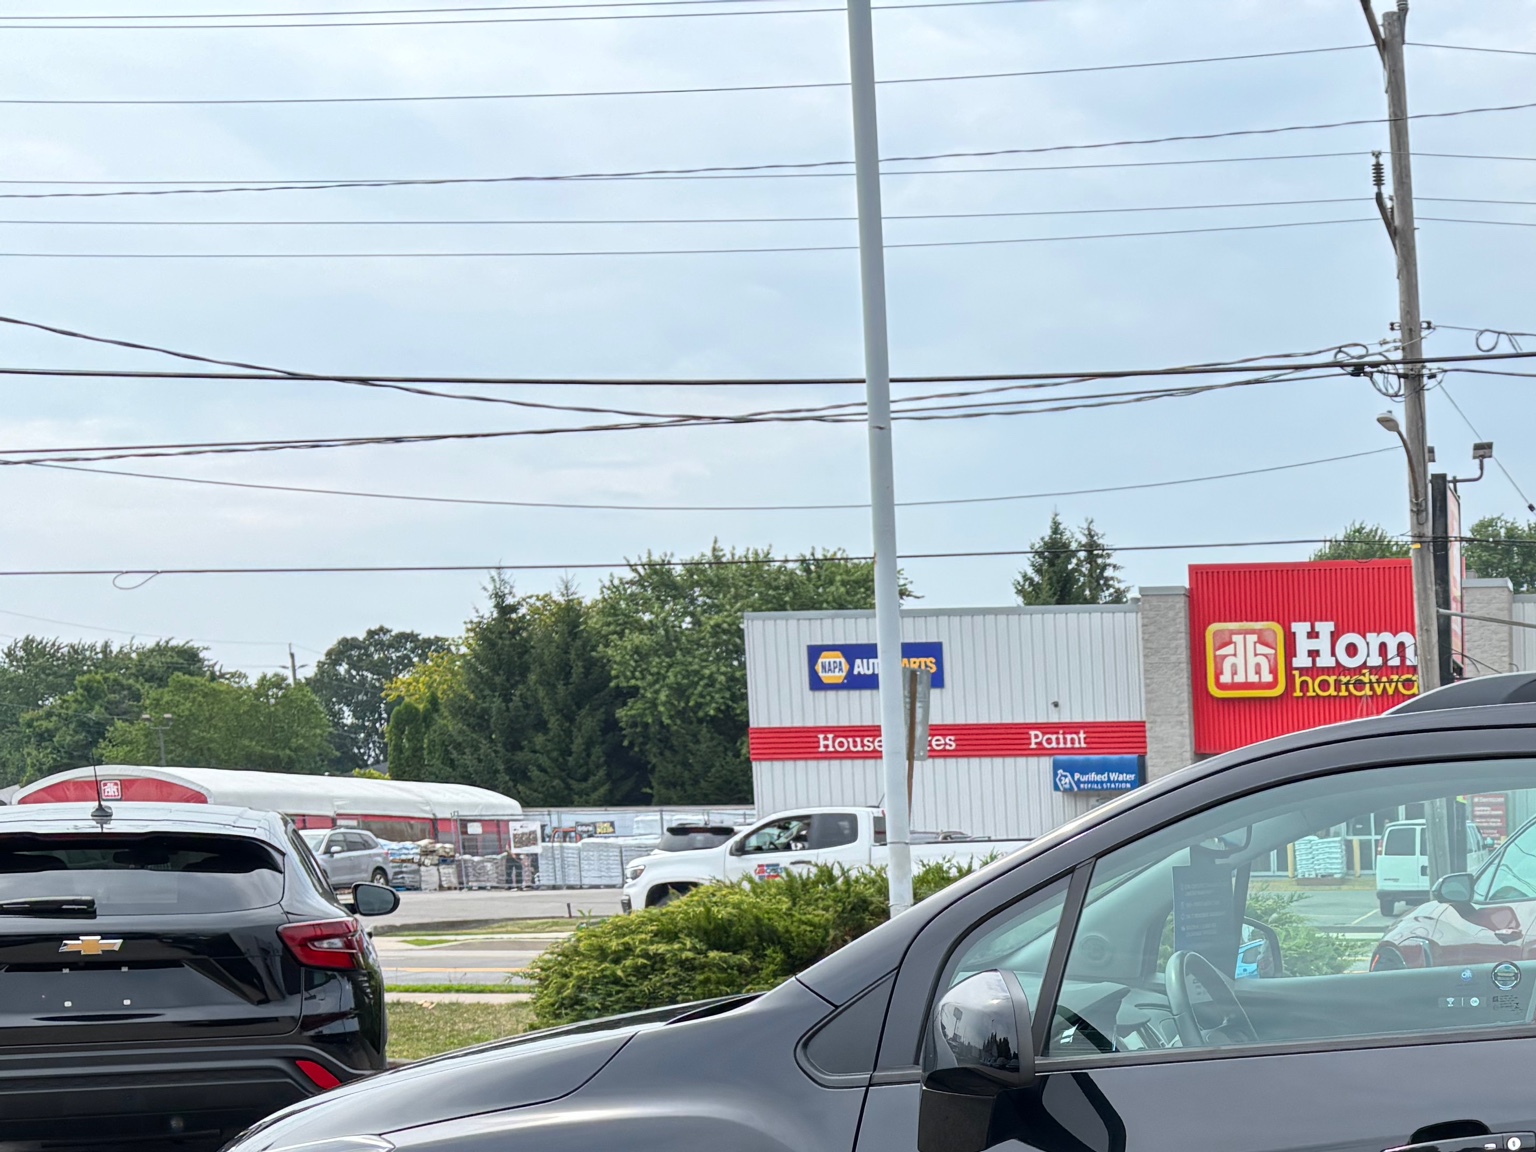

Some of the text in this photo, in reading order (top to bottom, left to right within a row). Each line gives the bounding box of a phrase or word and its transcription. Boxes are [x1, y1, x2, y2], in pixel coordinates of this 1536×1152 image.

[1290, 621, 1418, 668] Hom
[820, 657, 937, 675] NAPA AUT ARTS
[1292, 669, 1419, 697] hardwa
[1028, 730, 1087, 749] Paint
[1074, 771, 1136, 782] Purified Water
